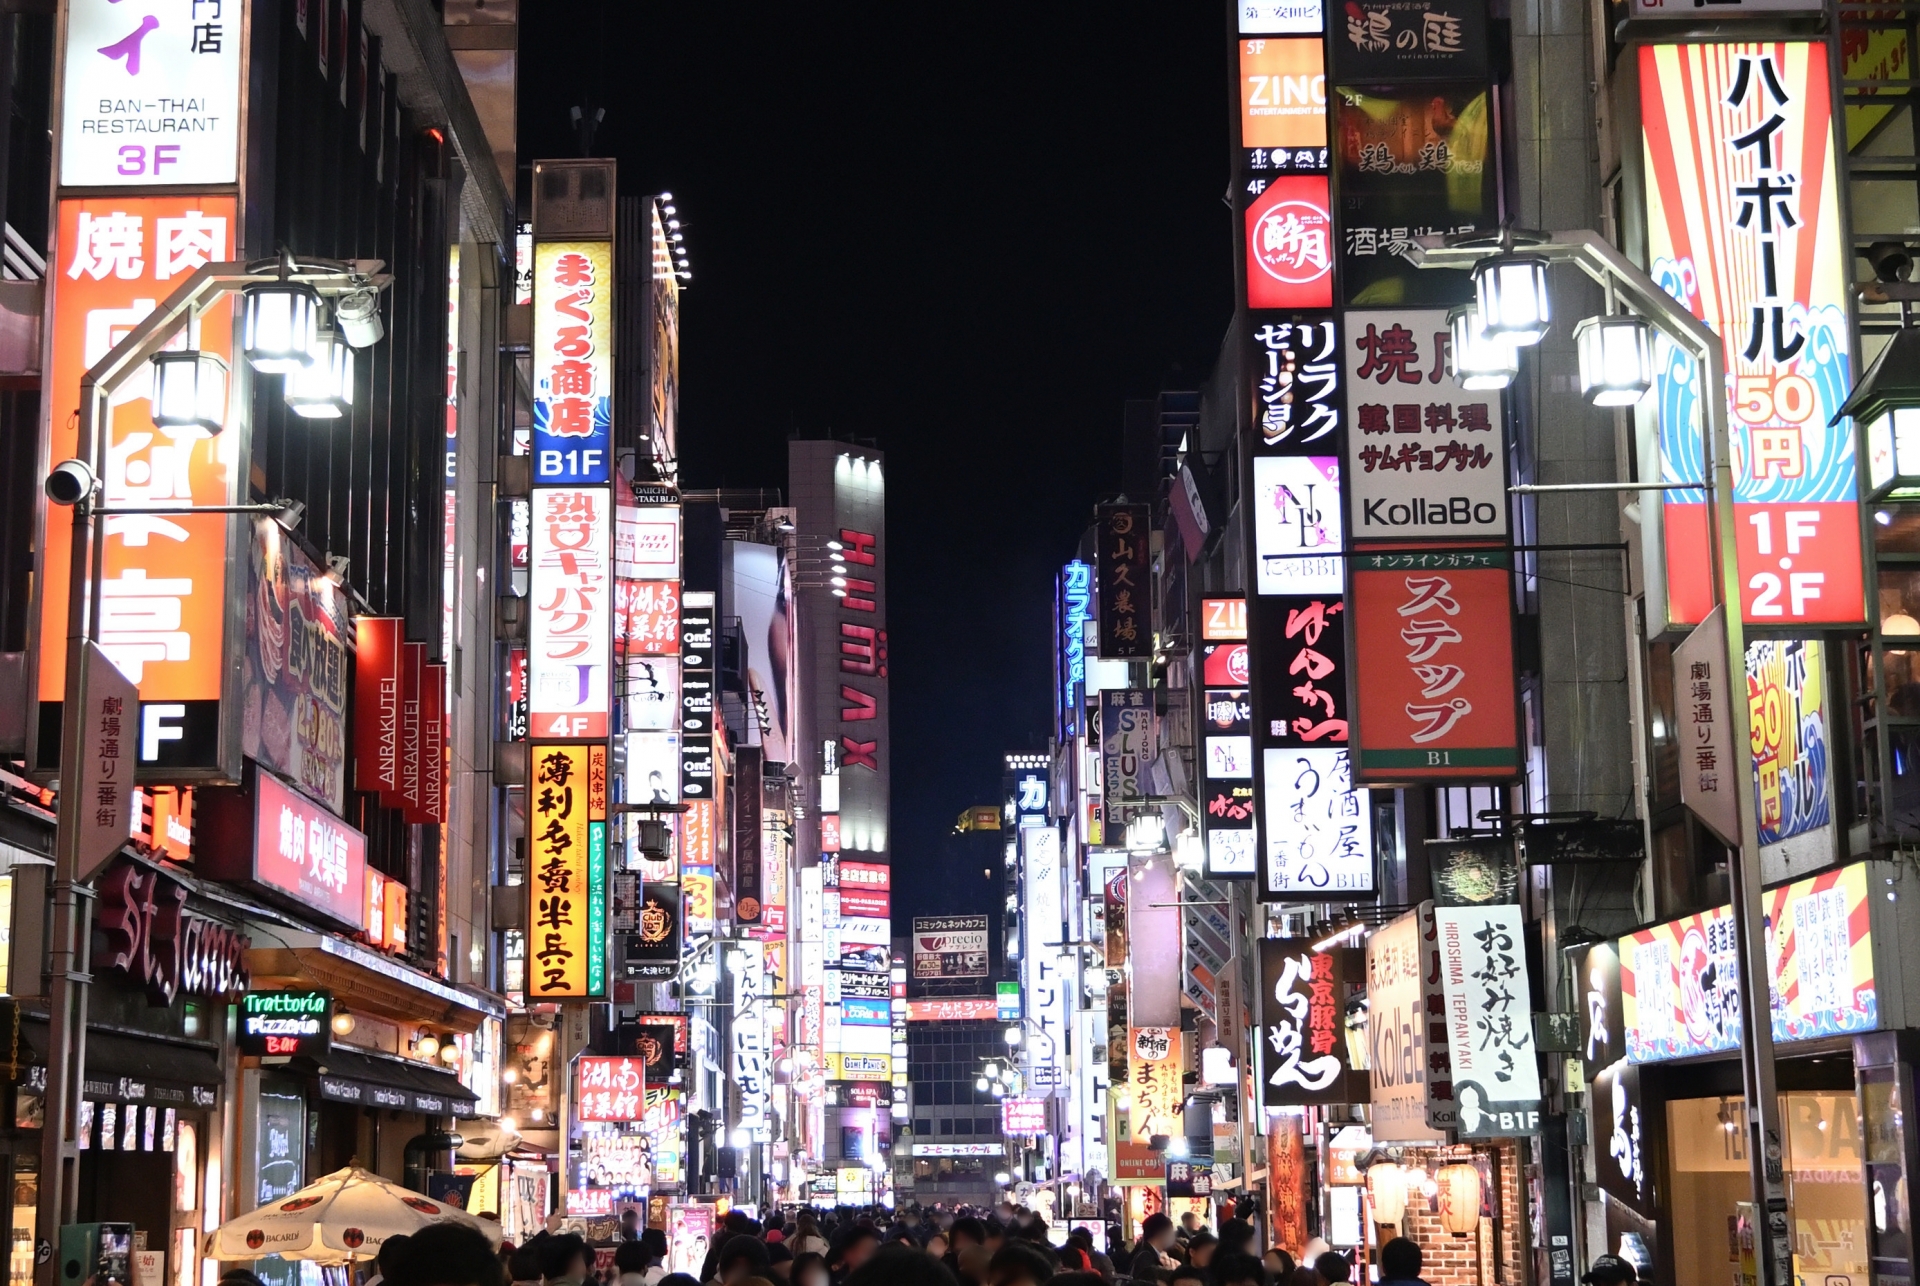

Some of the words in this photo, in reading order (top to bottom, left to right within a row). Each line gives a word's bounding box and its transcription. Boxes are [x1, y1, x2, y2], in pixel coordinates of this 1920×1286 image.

[1246, 40, 1266, 55] 5F
[99, 98, 205, 114] BAN-THAI
[1249, 106, 1313, 116] ENTERTAINMENT
[1344, 94, 1363, 106] 2F
[82, 117, 219, 134] RESTAURANT
[117, 145, 181, 176] 3F
[1246, 179, 1266, 195] 4F
[1727, 57, 1805, 363] ハイボール
[67, 211, 227, 281] 焼肉
[551, 253, 593, 435] まぐろ商店
[1735, 375, 1814, 425] 50
[1358, 402, 1492, 435] 韓国料理
[539, 449, 602, 476] B1F
[1750, 425, 1803, 479] 円
[660, 495, 678, 503] BLD
[1364, 496, 1497, 526] KollaBo
[1749, 510, 1821, 555] 1F
[1371, 553, 1491, 567] オンラインカフェ
[538, 490, 604, 660] 熟女キャバクラ
[629, 583, 679, 615] 湖南
[1749, 572, 1825, 617] 2F
[629, 614, 679, 642] 菜館
[644, 642, 663, 652] 4F
[1204, 645, 1215, 655] 4F
[1397, 575, 1473, 744] ステップ
[1111, 691, 1144, 707] 麻雀
[379, 677, 396, 784] ANRAKUTEI
[549, 714, 589, 737] 4F
[1690, 660, 1719, 793] 劇場通り一番街
[1749, 687, 1782, 755] 50
[96, 696, 123, 829] 劇場通り一番街
[402, 699, 419, 803] ANRAKUTEI
[1427, 751, 1451, 766] B1
[425, 719, 440, 819] ANRAKUTEI
[589, 752, 605, 811] 炭火串焼
[279, 804, 306, 865] 焼肉
[309, 817, 348, 894] 安楽亭
[1106, 869, 1118, 877] 3F
[1272, 840, 1291, 889] 一番街
[1336, 871, 1370, 888] B1F
[916, 919, 985, 930] コミック&ネットカフェ
[1188, 916, 1199, 927] 3
[1188, 939, 1199, 951] 2
[1445, 922, 1464, 986] HIROSHIMA
[1189, 984, 1203, 999] B1
[1309, 952, 1337, 1056] 東京豚骨
[1471, 920, 1530, 1082] お好み焼き
[921, 1001, 999, 1012] ゴールドラッシ
[937, 1010, 977, 1018] ハンバーグ
[265, 1035, 298, 1053] Bar
[1137, 1033, 1168, 1052] 新宿
[582, 1061, 639, 1090] 湖南
[1136, 1062, 1161, 1136] まっちゃん
[1432, 1111, 1457, 1123] Koll
[1499, 1111, 1540, 1130] B1F
[1437, 1178, 1453, 1217] 炭火
